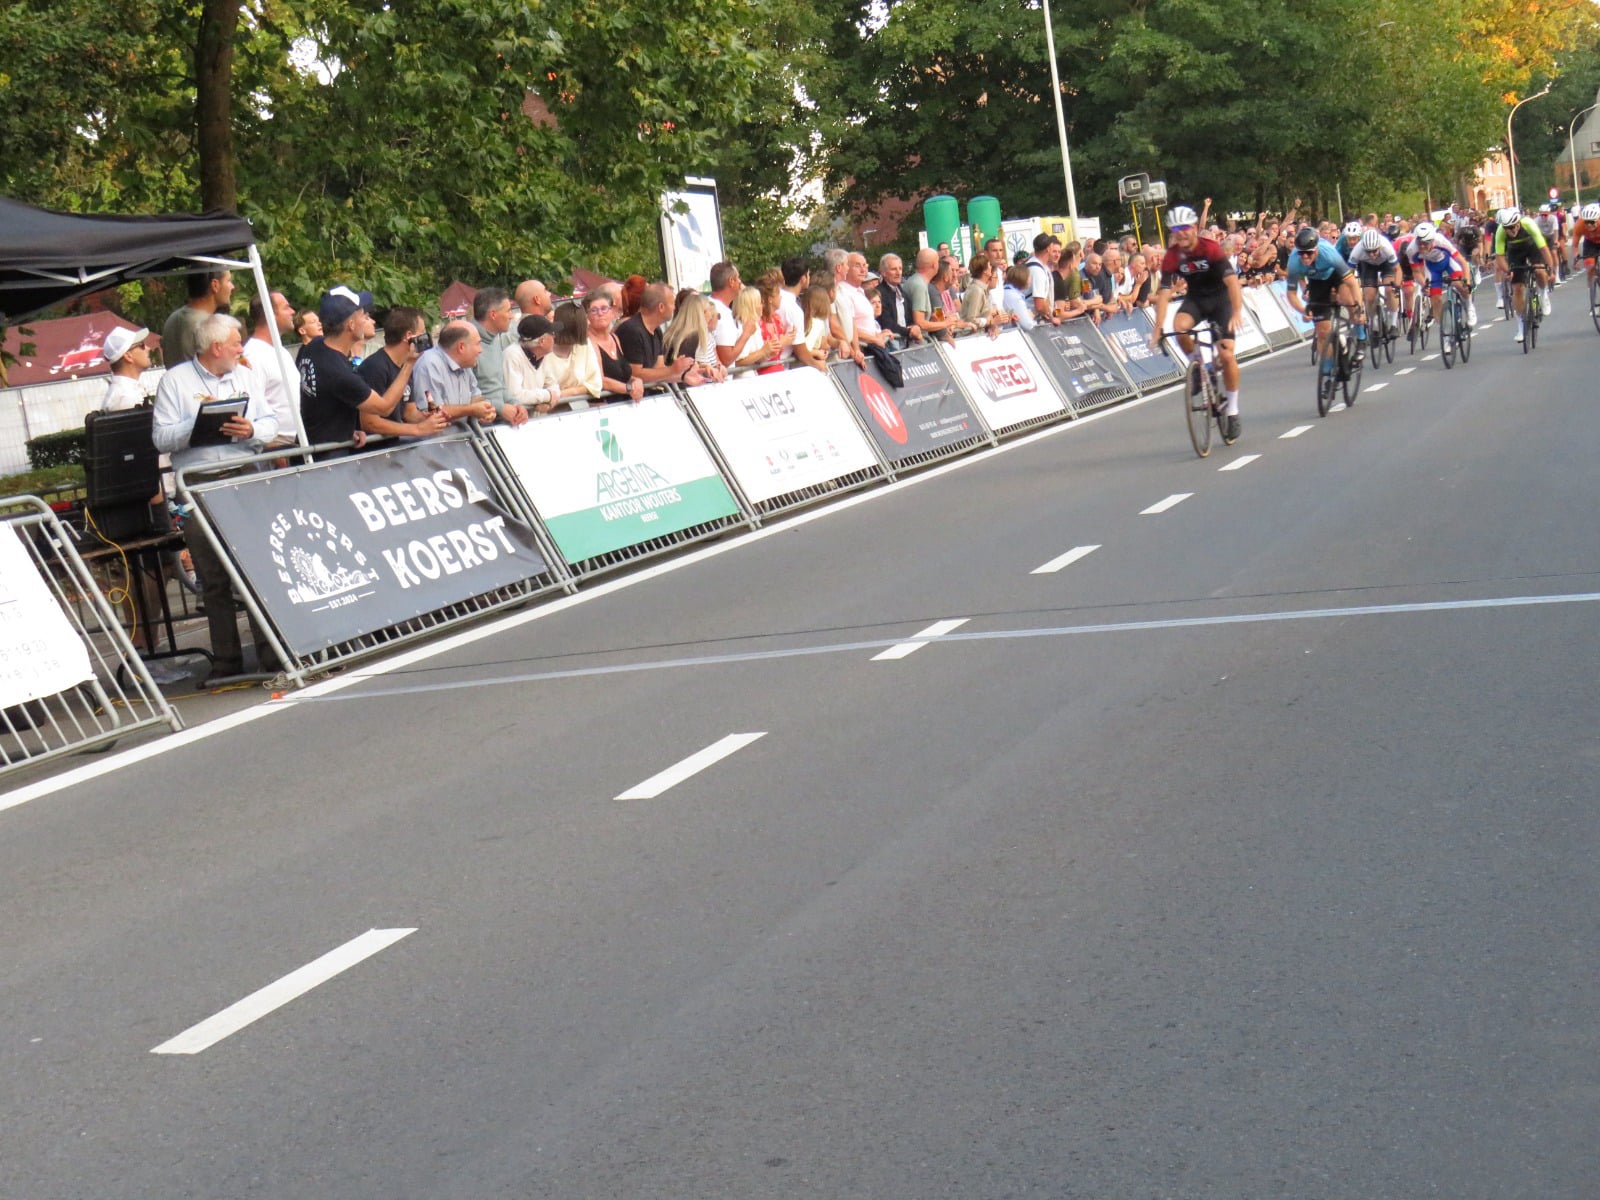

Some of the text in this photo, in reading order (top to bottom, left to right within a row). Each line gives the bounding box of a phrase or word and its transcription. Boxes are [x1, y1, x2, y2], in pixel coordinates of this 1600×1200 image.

[865, 391, 899, 430] W
[597, 463, 670, 502] ARGENTA
[600, 488, 682, 521] KANTOOR WOUTERS
[292, 508, 380, 581] KOERST
[382, 516, 516, 588] KOERST
